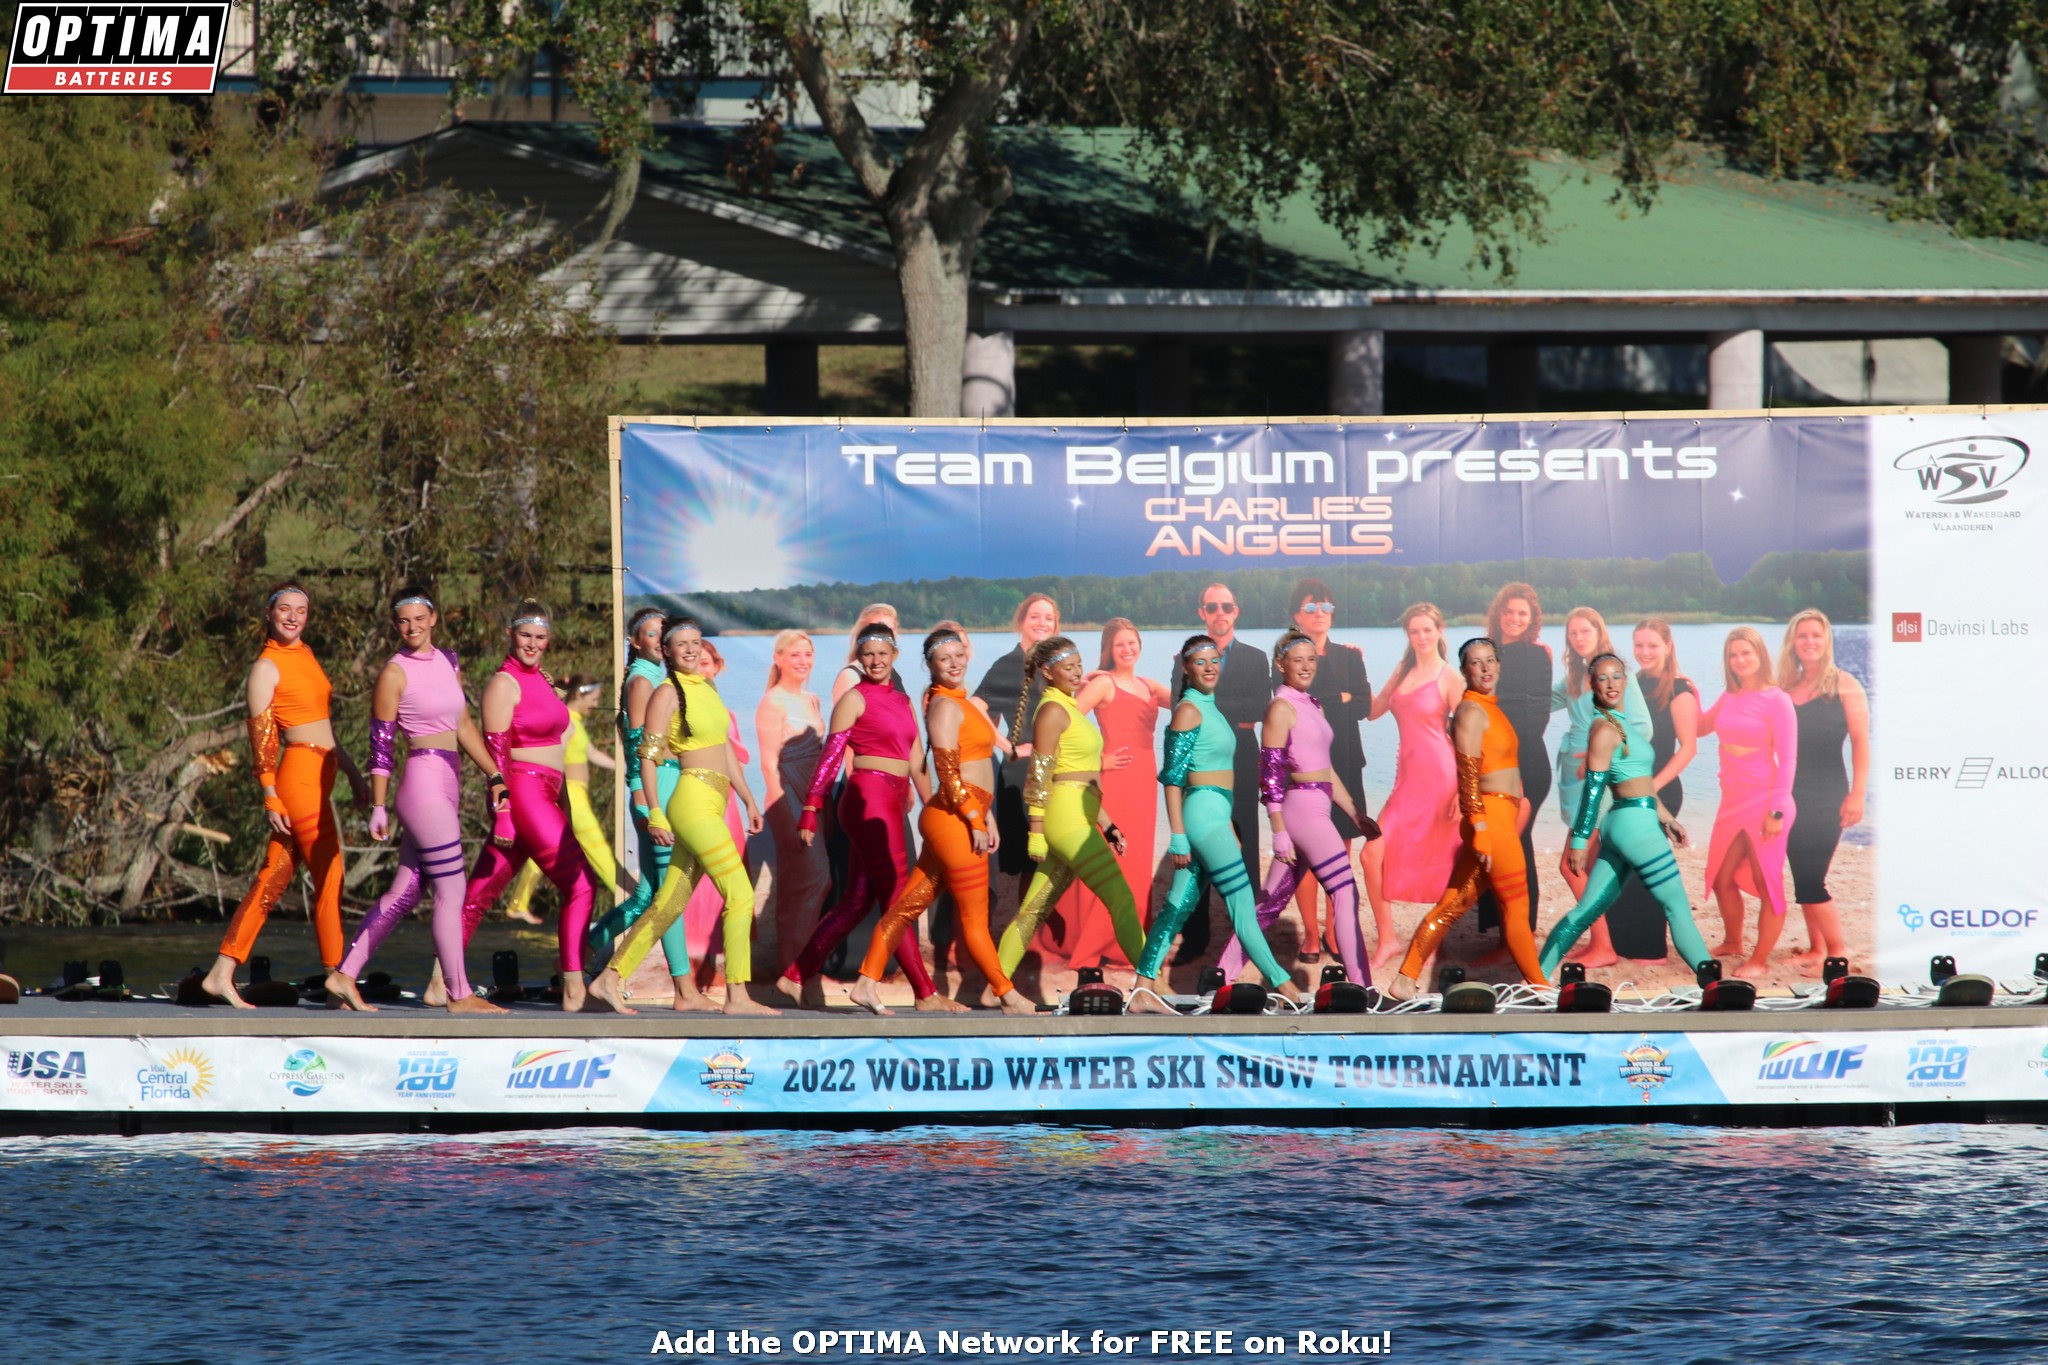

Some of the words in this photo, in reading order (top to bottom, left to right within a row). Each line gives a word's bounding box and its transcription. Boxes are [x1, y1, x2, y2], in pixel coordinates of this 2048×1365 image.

[841, 445, 1033, 485] Team
[1066, 445, 1335, 495] Belgium
[1367, 440, 1718, 494] presents
[1145, 496, 1393, 522] CHARLIE'S
[1145, 524, 1394, 557] ANGELS
[1927, 619, 1985, 636] Davinsi
[1992, 619, 2029, 636] Labs
[1894, 767, 1951, 780] BERRY
[1929, 909, 2038, 928] GELDOF
[7, 1050, 88, 1079] USA
[783, 1058, 856, 1092] 2022
[866, 1057, 994, 1092] WORLD
[1004, 1056, 1137, 1091] WATER
[1147, 1055, 1205, 1089] SKI
[1216, 1055, 1318, 1088] SHOW
[1329, 1053, 1586, 1088] TOURNAMENT
[1906, 1046, 1969, 1080] 100
[137, 1069, 188, 1084] Central
[269, 1071, 303, 1081] CYPRESS
[306, 1071, 345, 1081] GARDENS
[395, 1057, 459, 1090] 100
[42, 1088, 88, 1096] SPORTS
[54, 1081, 73, 1089] SKI
[75, 1081, 83, 1089] &
[141, 1085, 191, 1101] Florida
